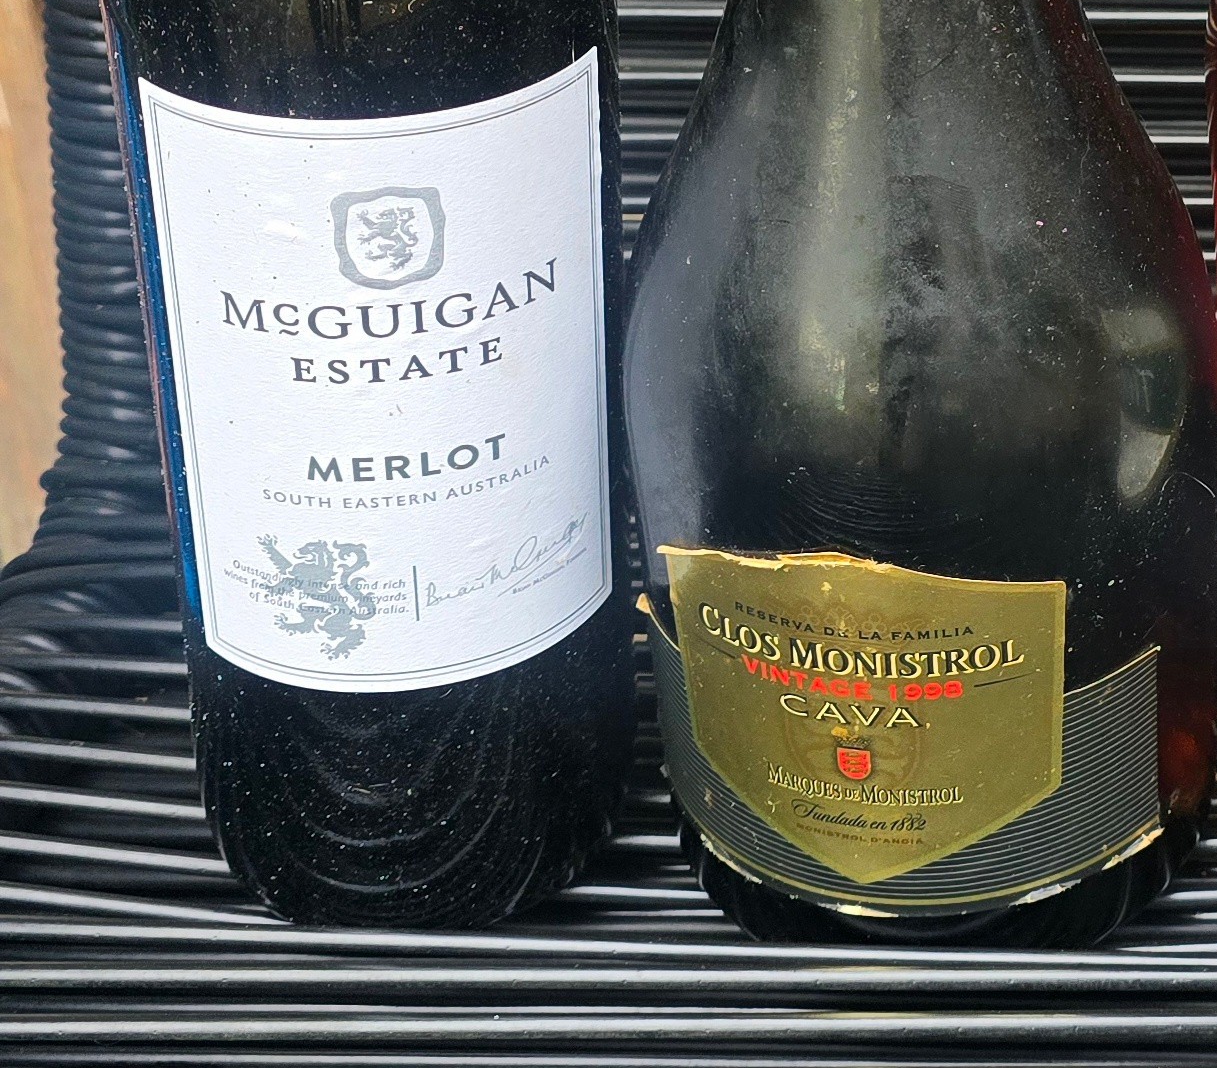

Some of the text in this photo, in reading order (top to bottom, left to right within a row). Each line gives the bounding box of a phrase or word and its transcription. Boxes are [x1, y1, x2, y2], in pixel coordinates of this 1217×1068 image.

[220, 258, 557, 340] McGUIGAN
[290, 336, 503, 384] ESTATE
[307, 433, 506, 483] MERLOT
[263, 455, 550, 509] SOUTH EASTERN AUSTRALIA
[223, 568, 248, 584] wines
[298, 591, 348, 603] premium
[249, 592, 260, 602] of
[263, 596, 295, 609] South
[355, 581, 379, 591] and
[383, 579, 406, 589] rich
[699, 602, 1025, 680] CLOS MONISTROL
[735, 601, 815, 633] RESERVA
[858, 629, 882, 640] LA
[891, 626, 974, 641] FAMILIA
[740, 653, 965, 701] VINTAGE 1998
[779, 693, 922, 729] CAVA
[767, 761, 843, 801] MARQUES
[861, 784, 964, 807] MONISTROL
[791, 798, 927, 832] Fundada en 1882
